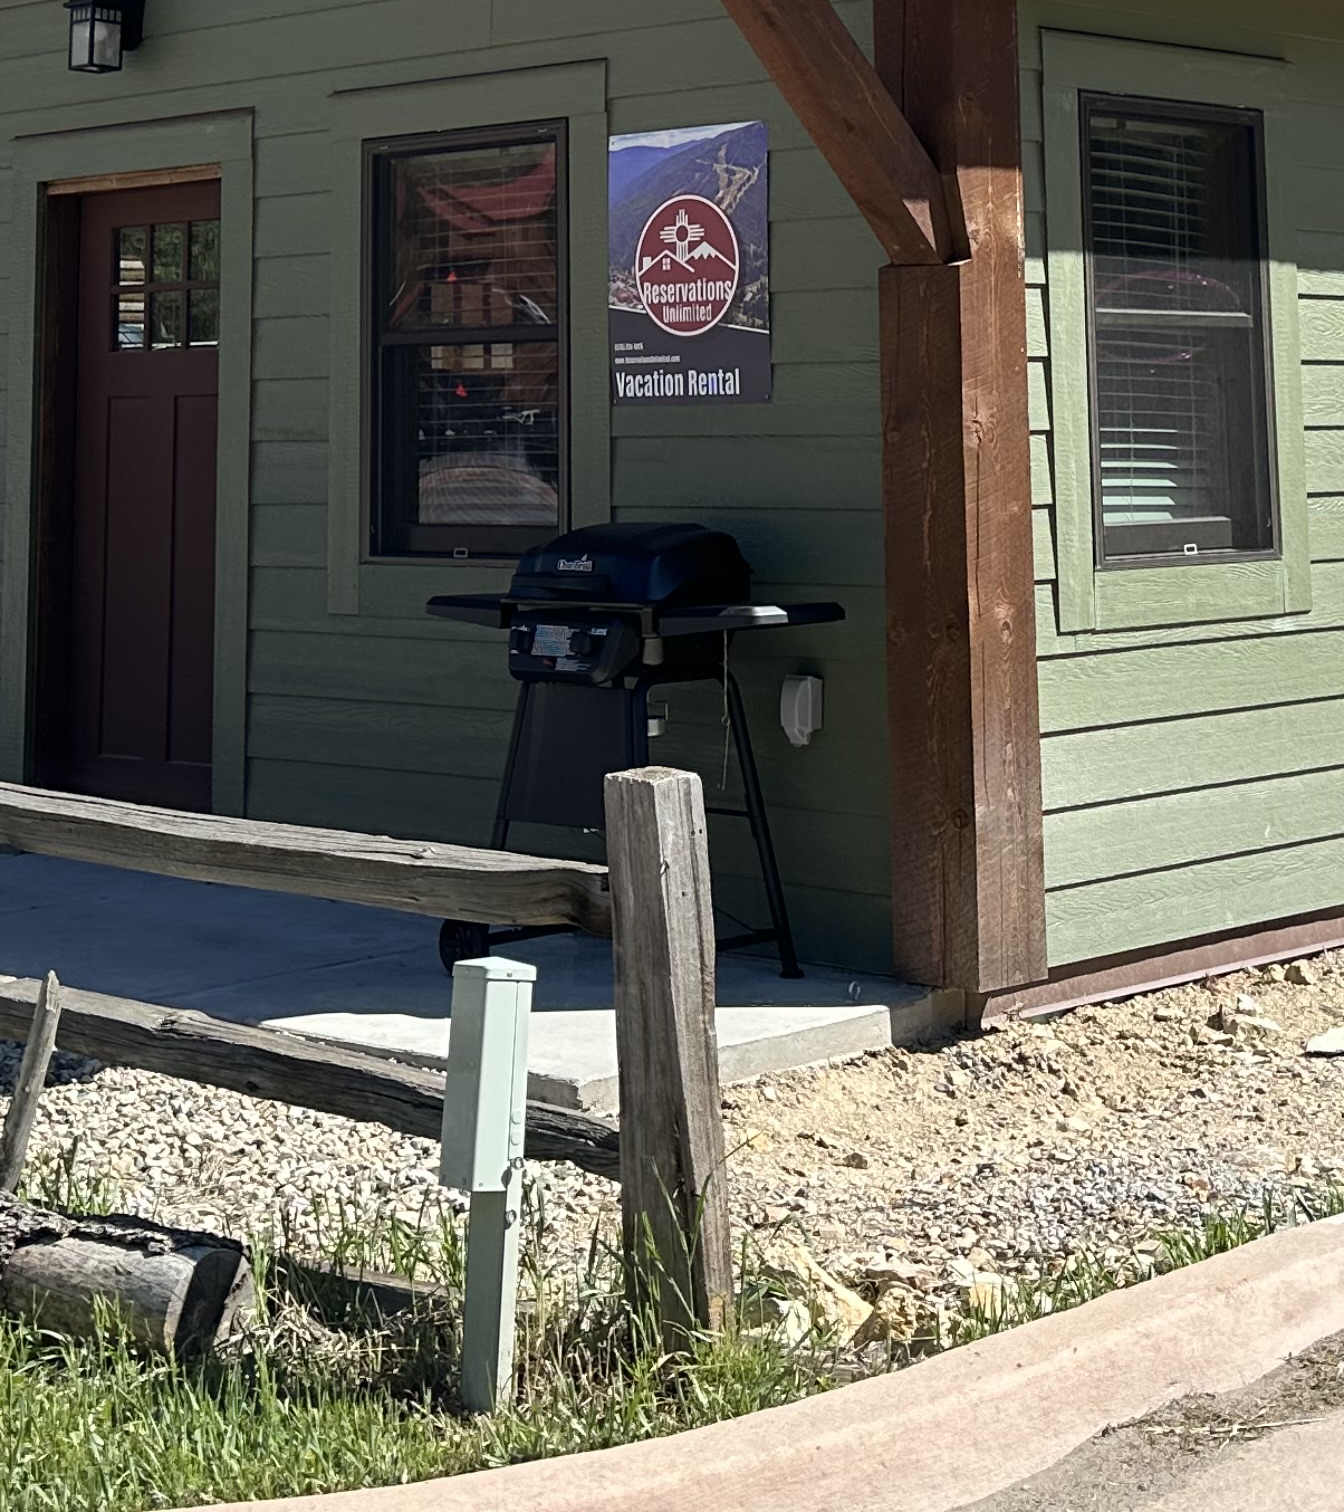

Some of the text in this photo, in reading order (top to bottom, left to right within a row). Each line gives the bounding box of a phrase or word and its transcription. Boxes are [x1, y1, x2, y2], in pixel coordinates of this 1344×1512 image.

[643, 277, 732, 304] Reservations
[662, 303, 712, 323] Unlimited
[615, 368, 740, 397] Vacation Rental
